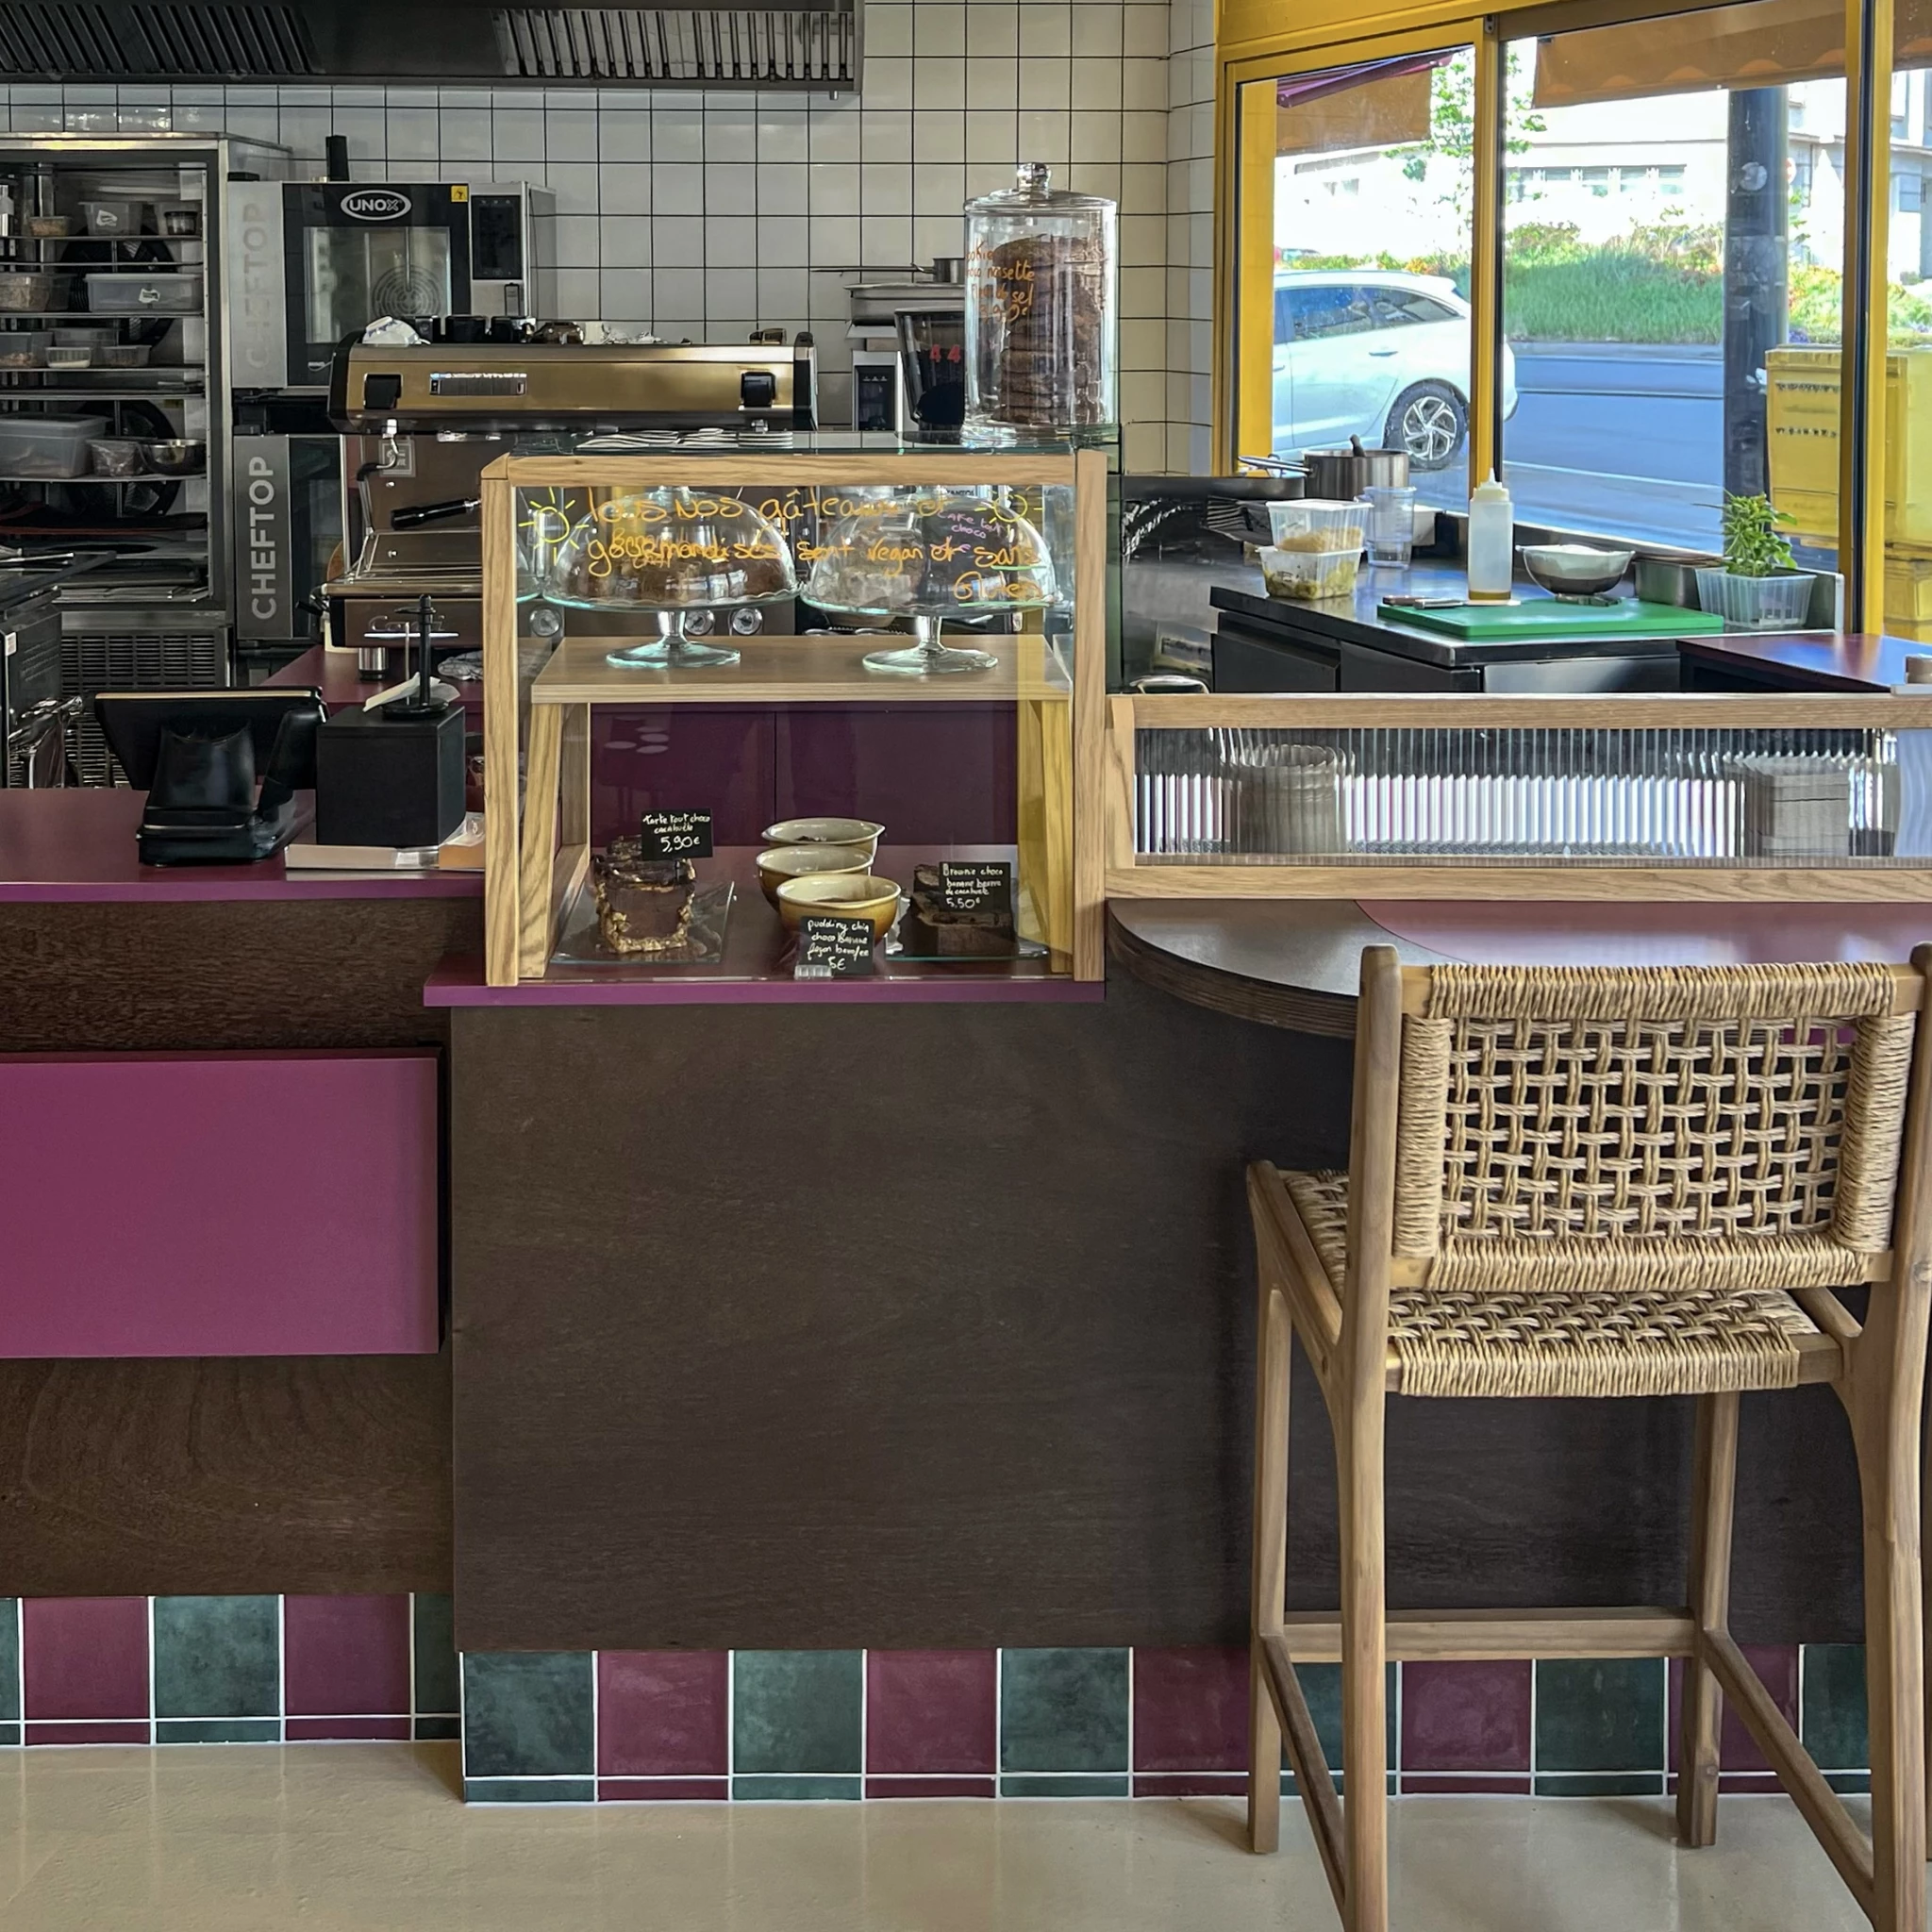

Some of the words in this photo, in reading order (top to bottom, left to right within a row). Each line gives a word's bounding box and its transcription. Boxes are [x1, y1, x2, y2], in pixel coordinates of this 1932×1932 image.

[349, 198, 399, 211] UNOX
[248, 456, 277, 620] CHEFTOP
[660, 835, 700, 853] 5,90€
[980, 865, 1004, 875] choco
[827, 956, 846, 970] 5€
